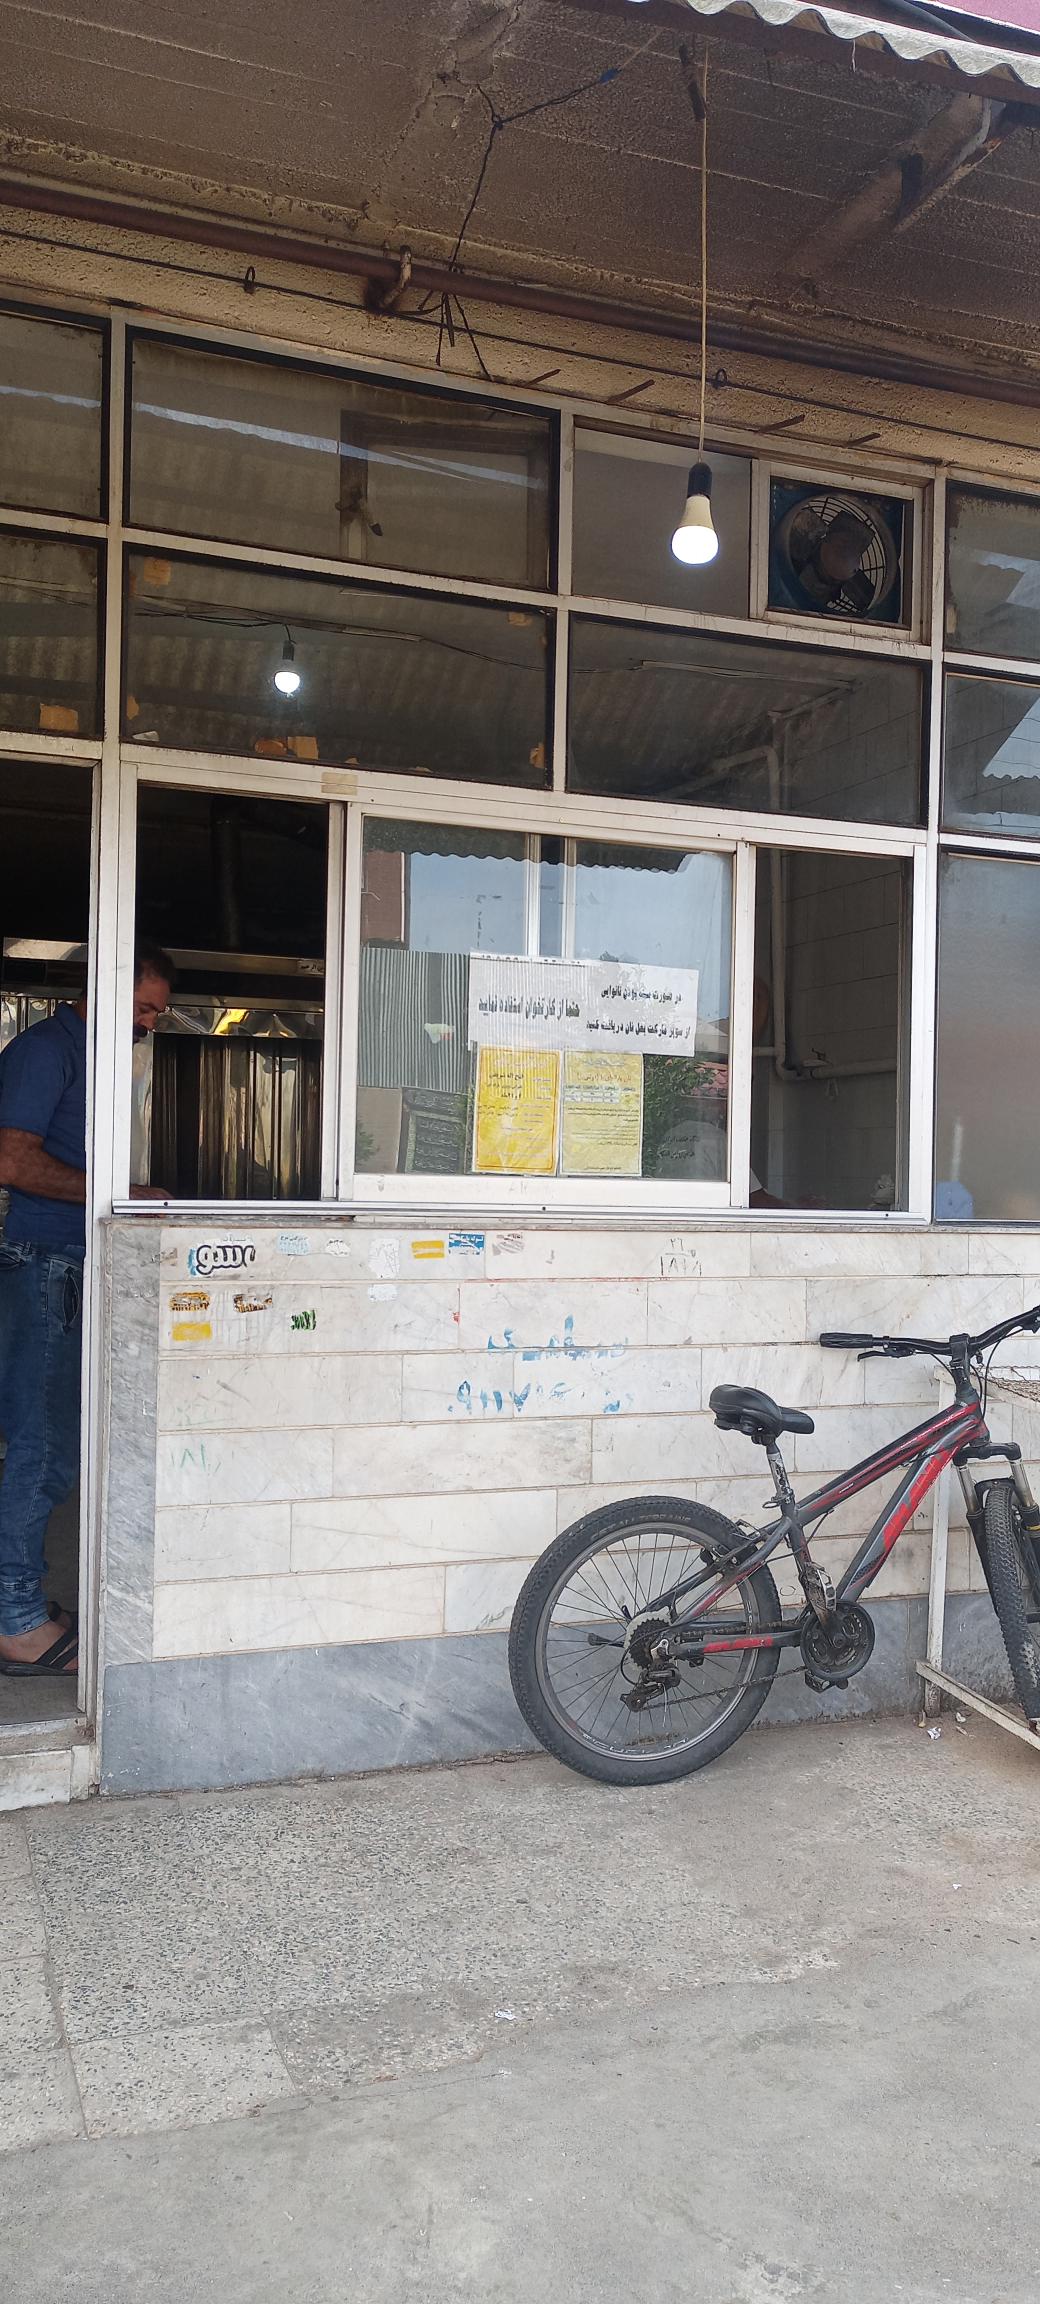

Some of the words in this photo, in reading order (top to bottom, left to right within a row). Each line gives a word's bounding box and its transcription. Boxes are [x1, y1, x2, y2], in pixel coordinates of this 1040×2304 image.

[601, 985, 621, 999] نانوایی
[623, 988, 637, 1000] بودن
[652, 990, 672, 1003] صورت
[674, 993, 682, 1004] در
[500, 995, 523, 1014] استفاده
[525, 996, 556, 1019] کارتخوان
[557, 999, 564, 1020] از
[565, 999, 580, 1017] حتما
[586, 1019, 599, 1032] کنید
[600, 1020, 624, 1034] دریافت
[625, 1021, 634, 1035] نان
[684, 1026, 691, 1039] از
